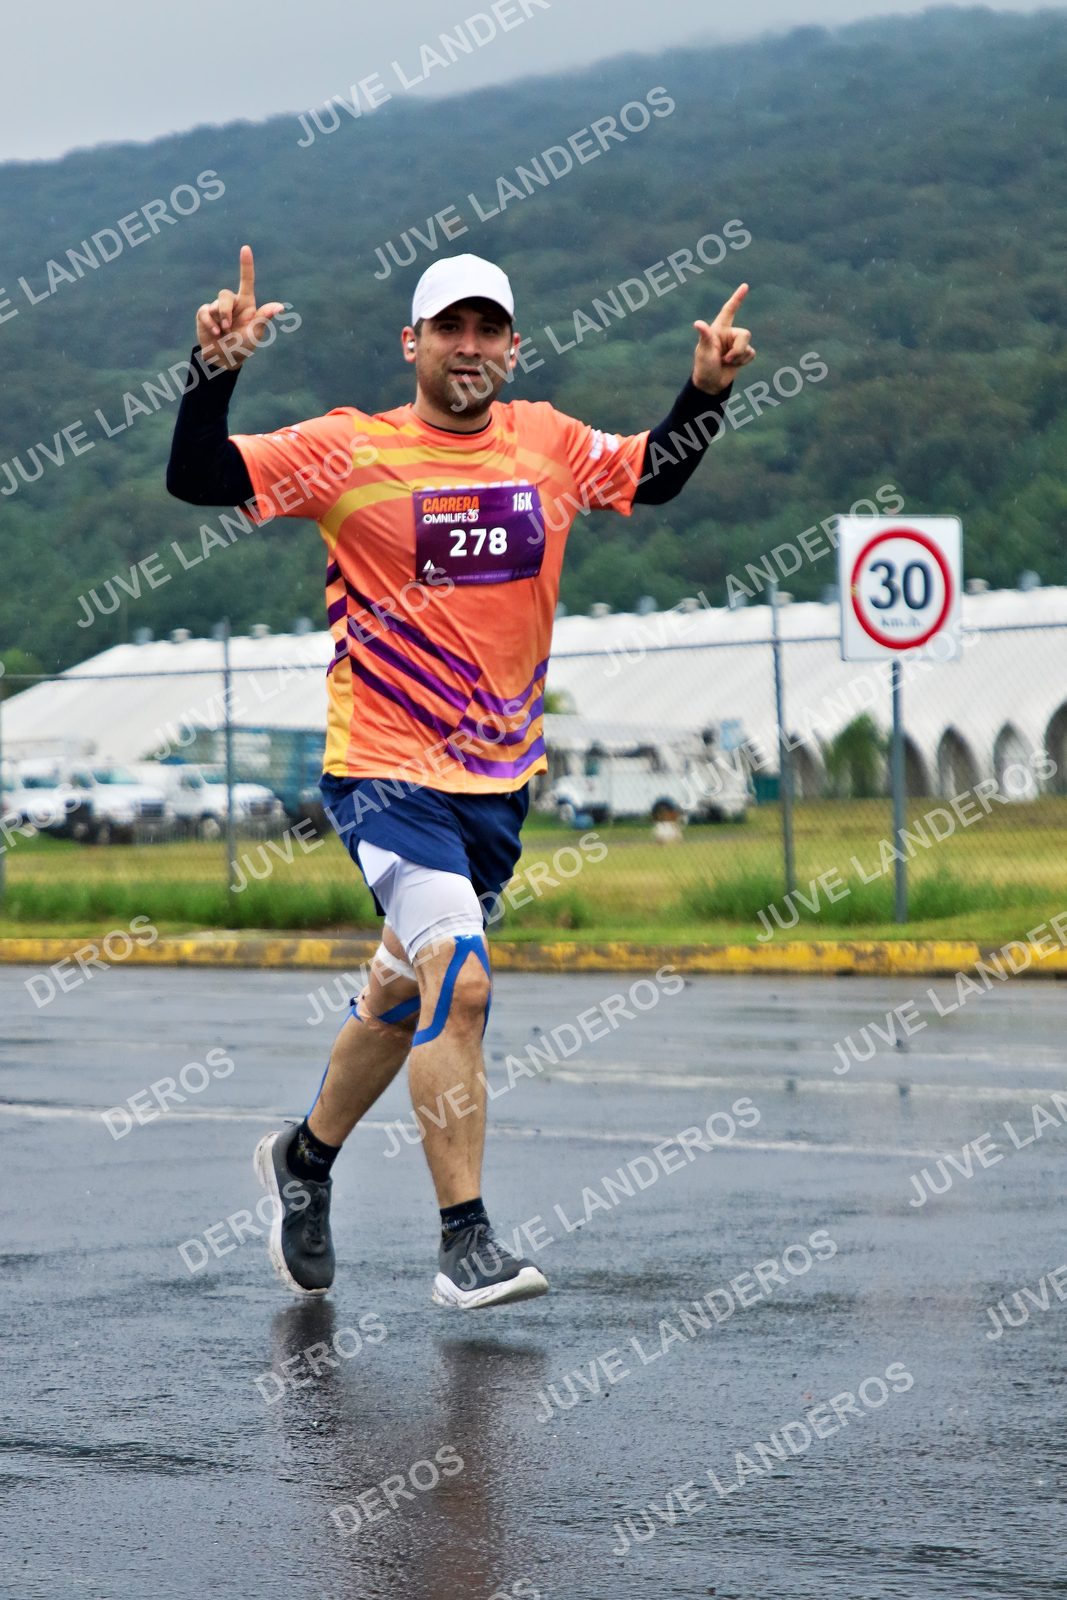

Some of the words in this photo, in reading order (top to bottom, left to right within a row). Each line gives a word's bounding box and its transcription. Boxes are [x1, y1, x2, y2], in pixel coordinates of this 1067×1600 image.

[422, 495, 480, 513] CARRERA
[449, 527, 508, 557] 278
[869, 559, 933, 610] 30
